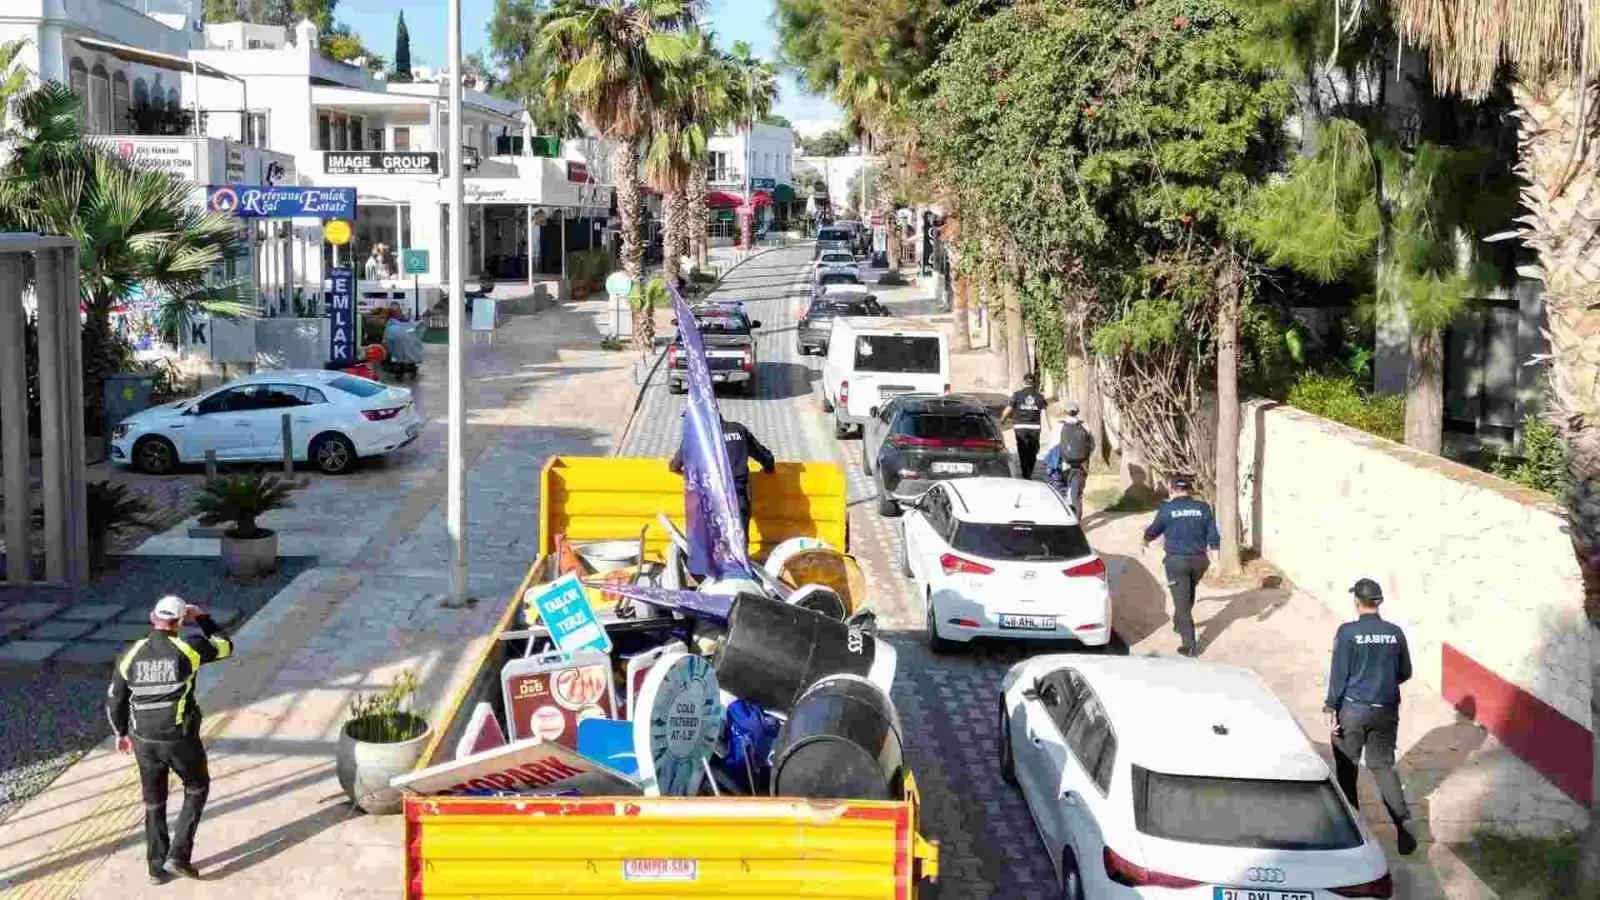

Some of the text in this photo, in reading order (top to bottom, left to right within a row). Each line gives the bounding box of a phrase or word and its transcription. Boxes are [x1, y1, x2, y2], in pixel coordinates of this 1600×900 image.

[328, 156, 431, 168] IMAGE GROUP
[332, 278, 349, 358] EMLAK
[1355, 634, 1398, 644] ZABITA
[677, 703, 696, 713] COLD
